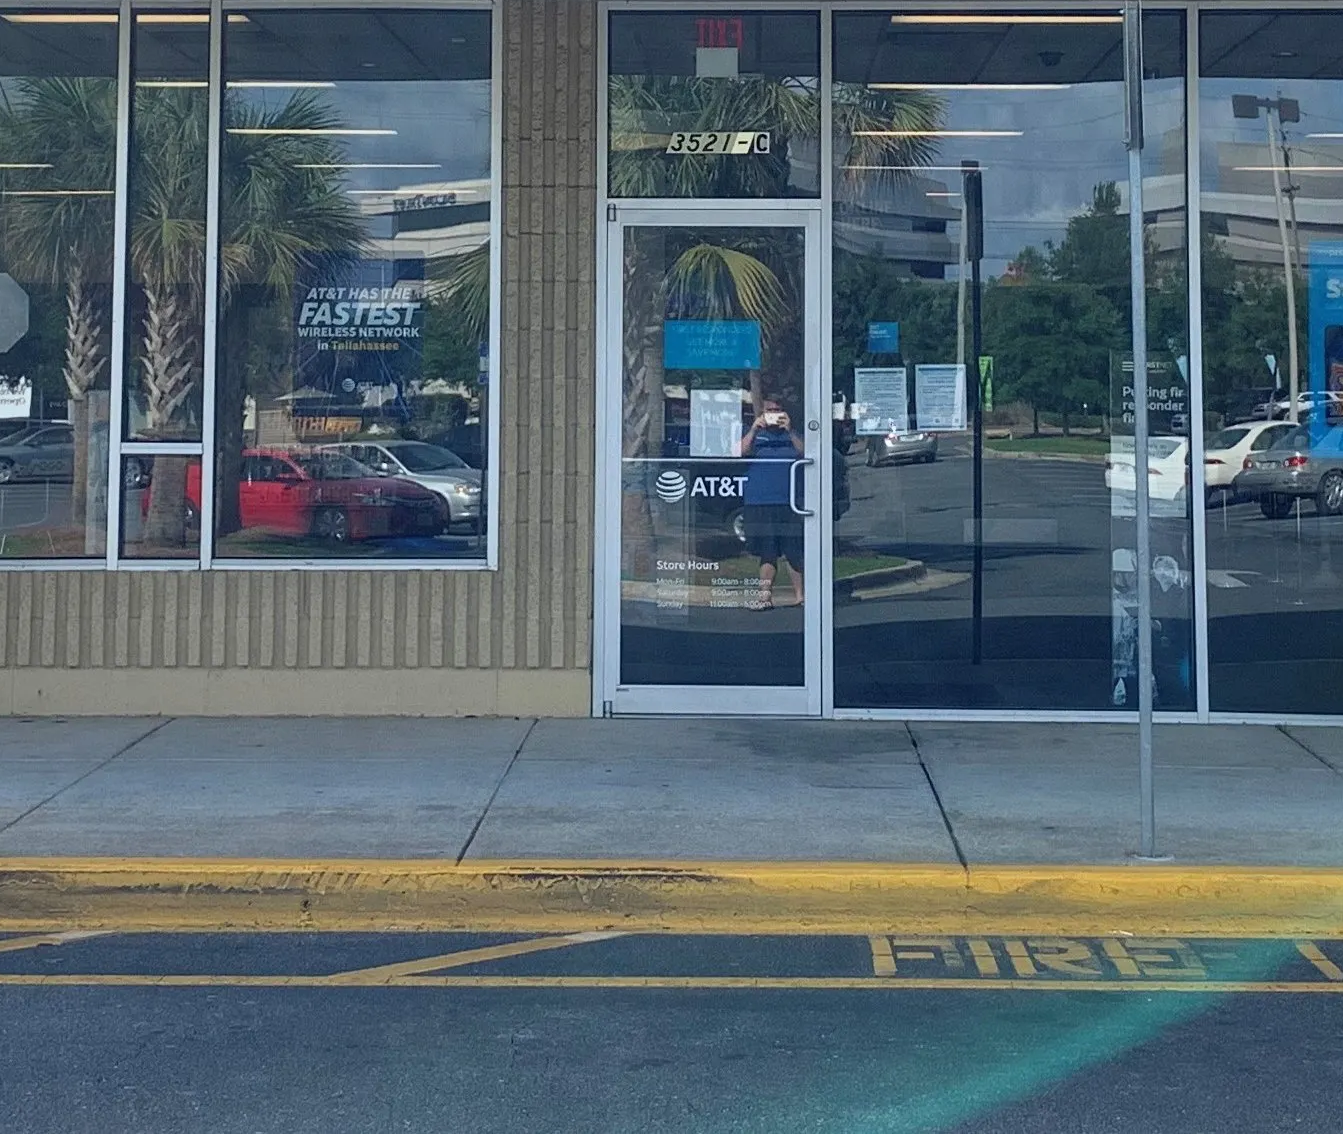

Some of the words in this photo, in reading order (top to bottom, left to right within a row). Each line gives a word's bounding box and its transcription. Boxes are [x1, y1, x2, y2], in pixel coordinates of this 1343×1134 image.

[670, 133, 769, 153] 3521-C
[307, 287, 347, 300] AT&T
[348, 287, 381, 300] HAS
[382, 287, 412, 300] THE
[298, 302, 421, 326] FASTEST
[297, 327, 355, 338] WIRELESS
[358, 327, 420, 338] NETWORK
[317, 341, 329, 351] in
[1122, 386, 1167, 399] Ping
[690, 476, 749, 497] AT&T
[656, 560, 685, 570] Store
[688, 560, 720, 570] Hours
[711, 578, 738, 586] 9:00am
[870, 935, 1209, 979] FIRE
